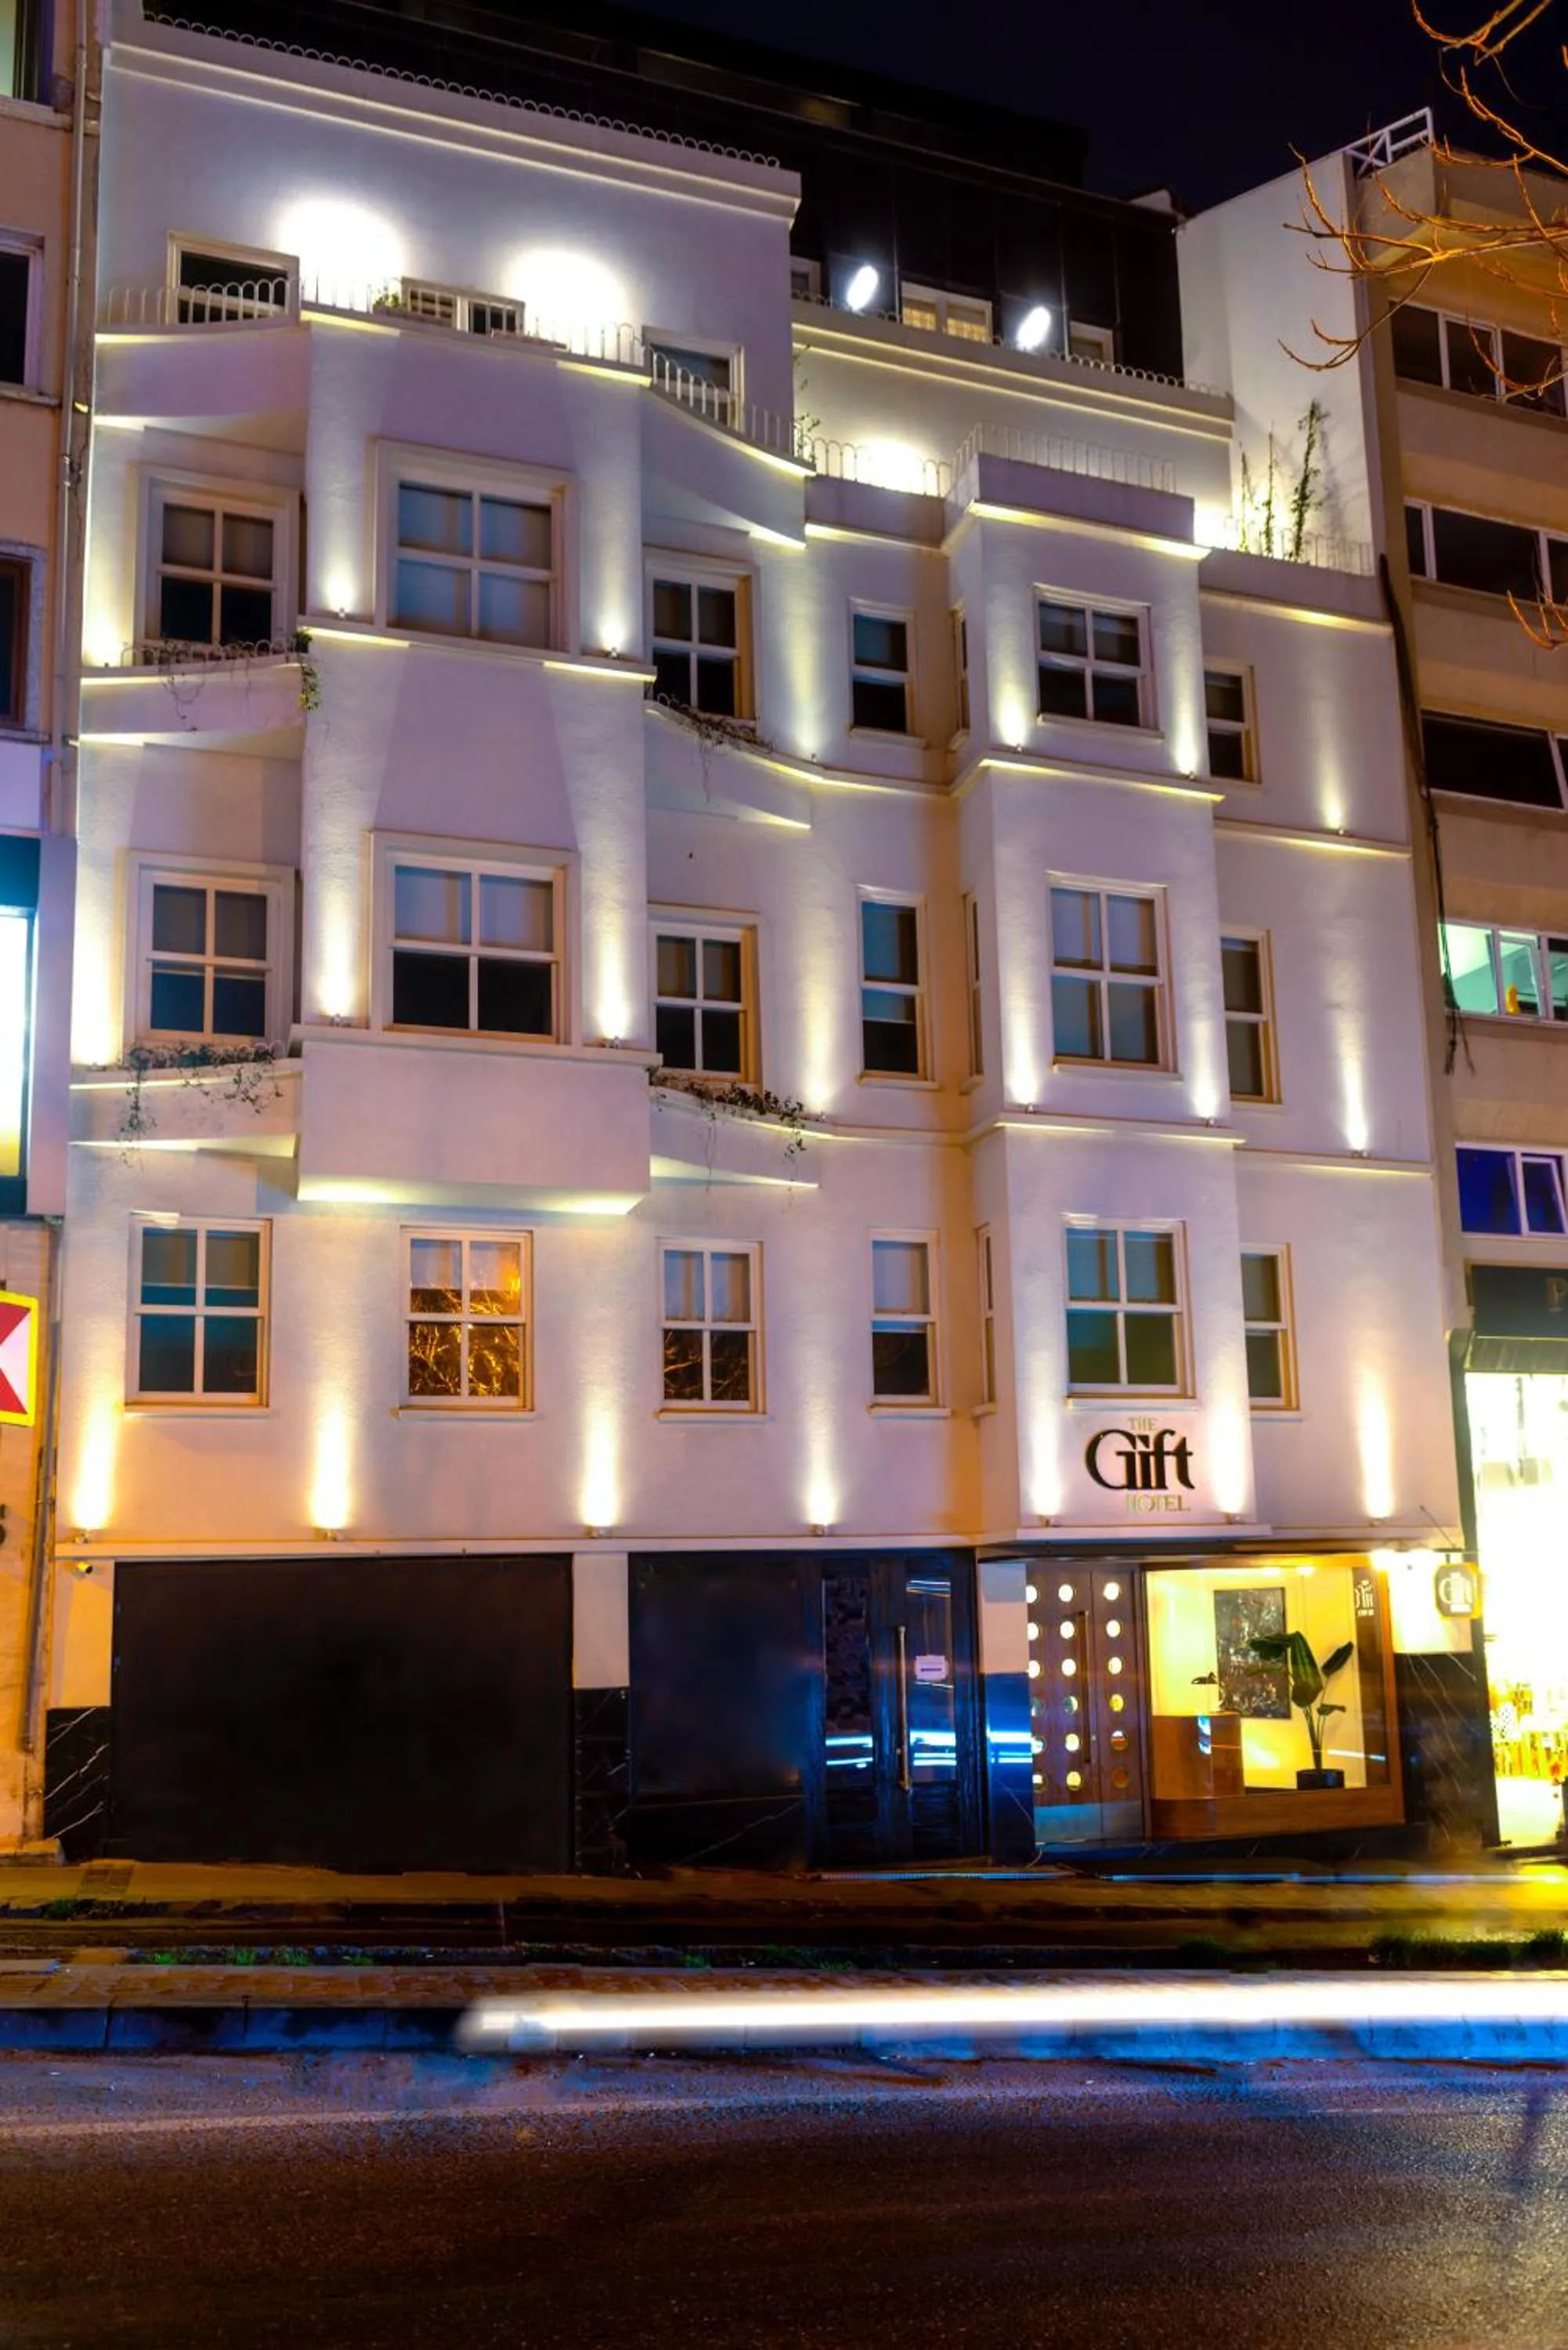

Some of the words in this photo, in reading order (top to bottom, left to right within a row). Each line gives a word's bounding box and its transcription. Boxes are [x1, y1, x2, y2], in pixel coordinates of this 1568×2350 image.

[1128, 1418, 1157, 1430] THE
[1085, 1429, 1195, 1490] Gift
[1126, 1495, 1190, 1513] HOTEL
